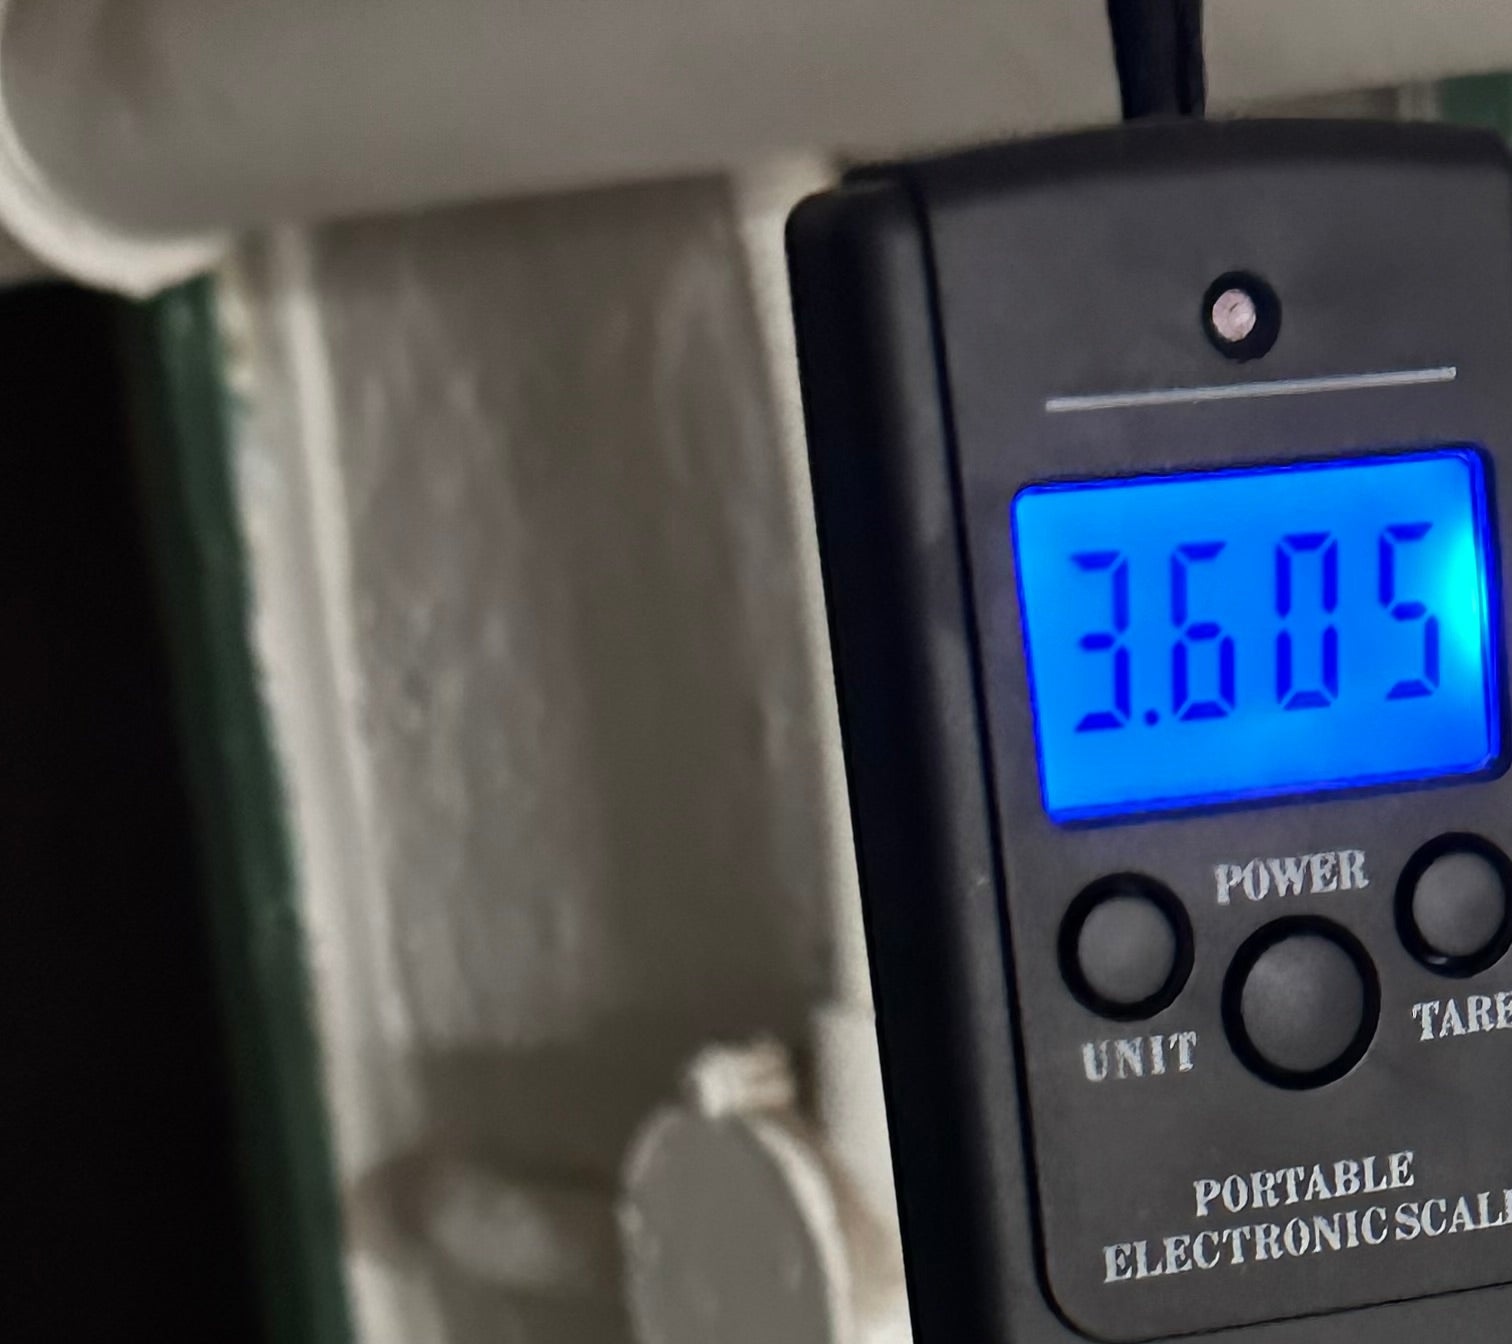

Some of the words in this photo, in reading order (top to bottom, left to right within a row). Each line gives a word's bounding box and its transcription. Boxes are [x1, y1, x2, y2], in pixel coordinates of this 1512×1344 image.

[1069, 521, 1440, 733] 3.605
[1214, 849, 1370, 905] POWER
[1081, 1031, 1198, 1083] UNIT
[1193, 1150, 1416, 1217] PORTABLE
[1103, 1207, 1389, 1284] ELECTRONIC
